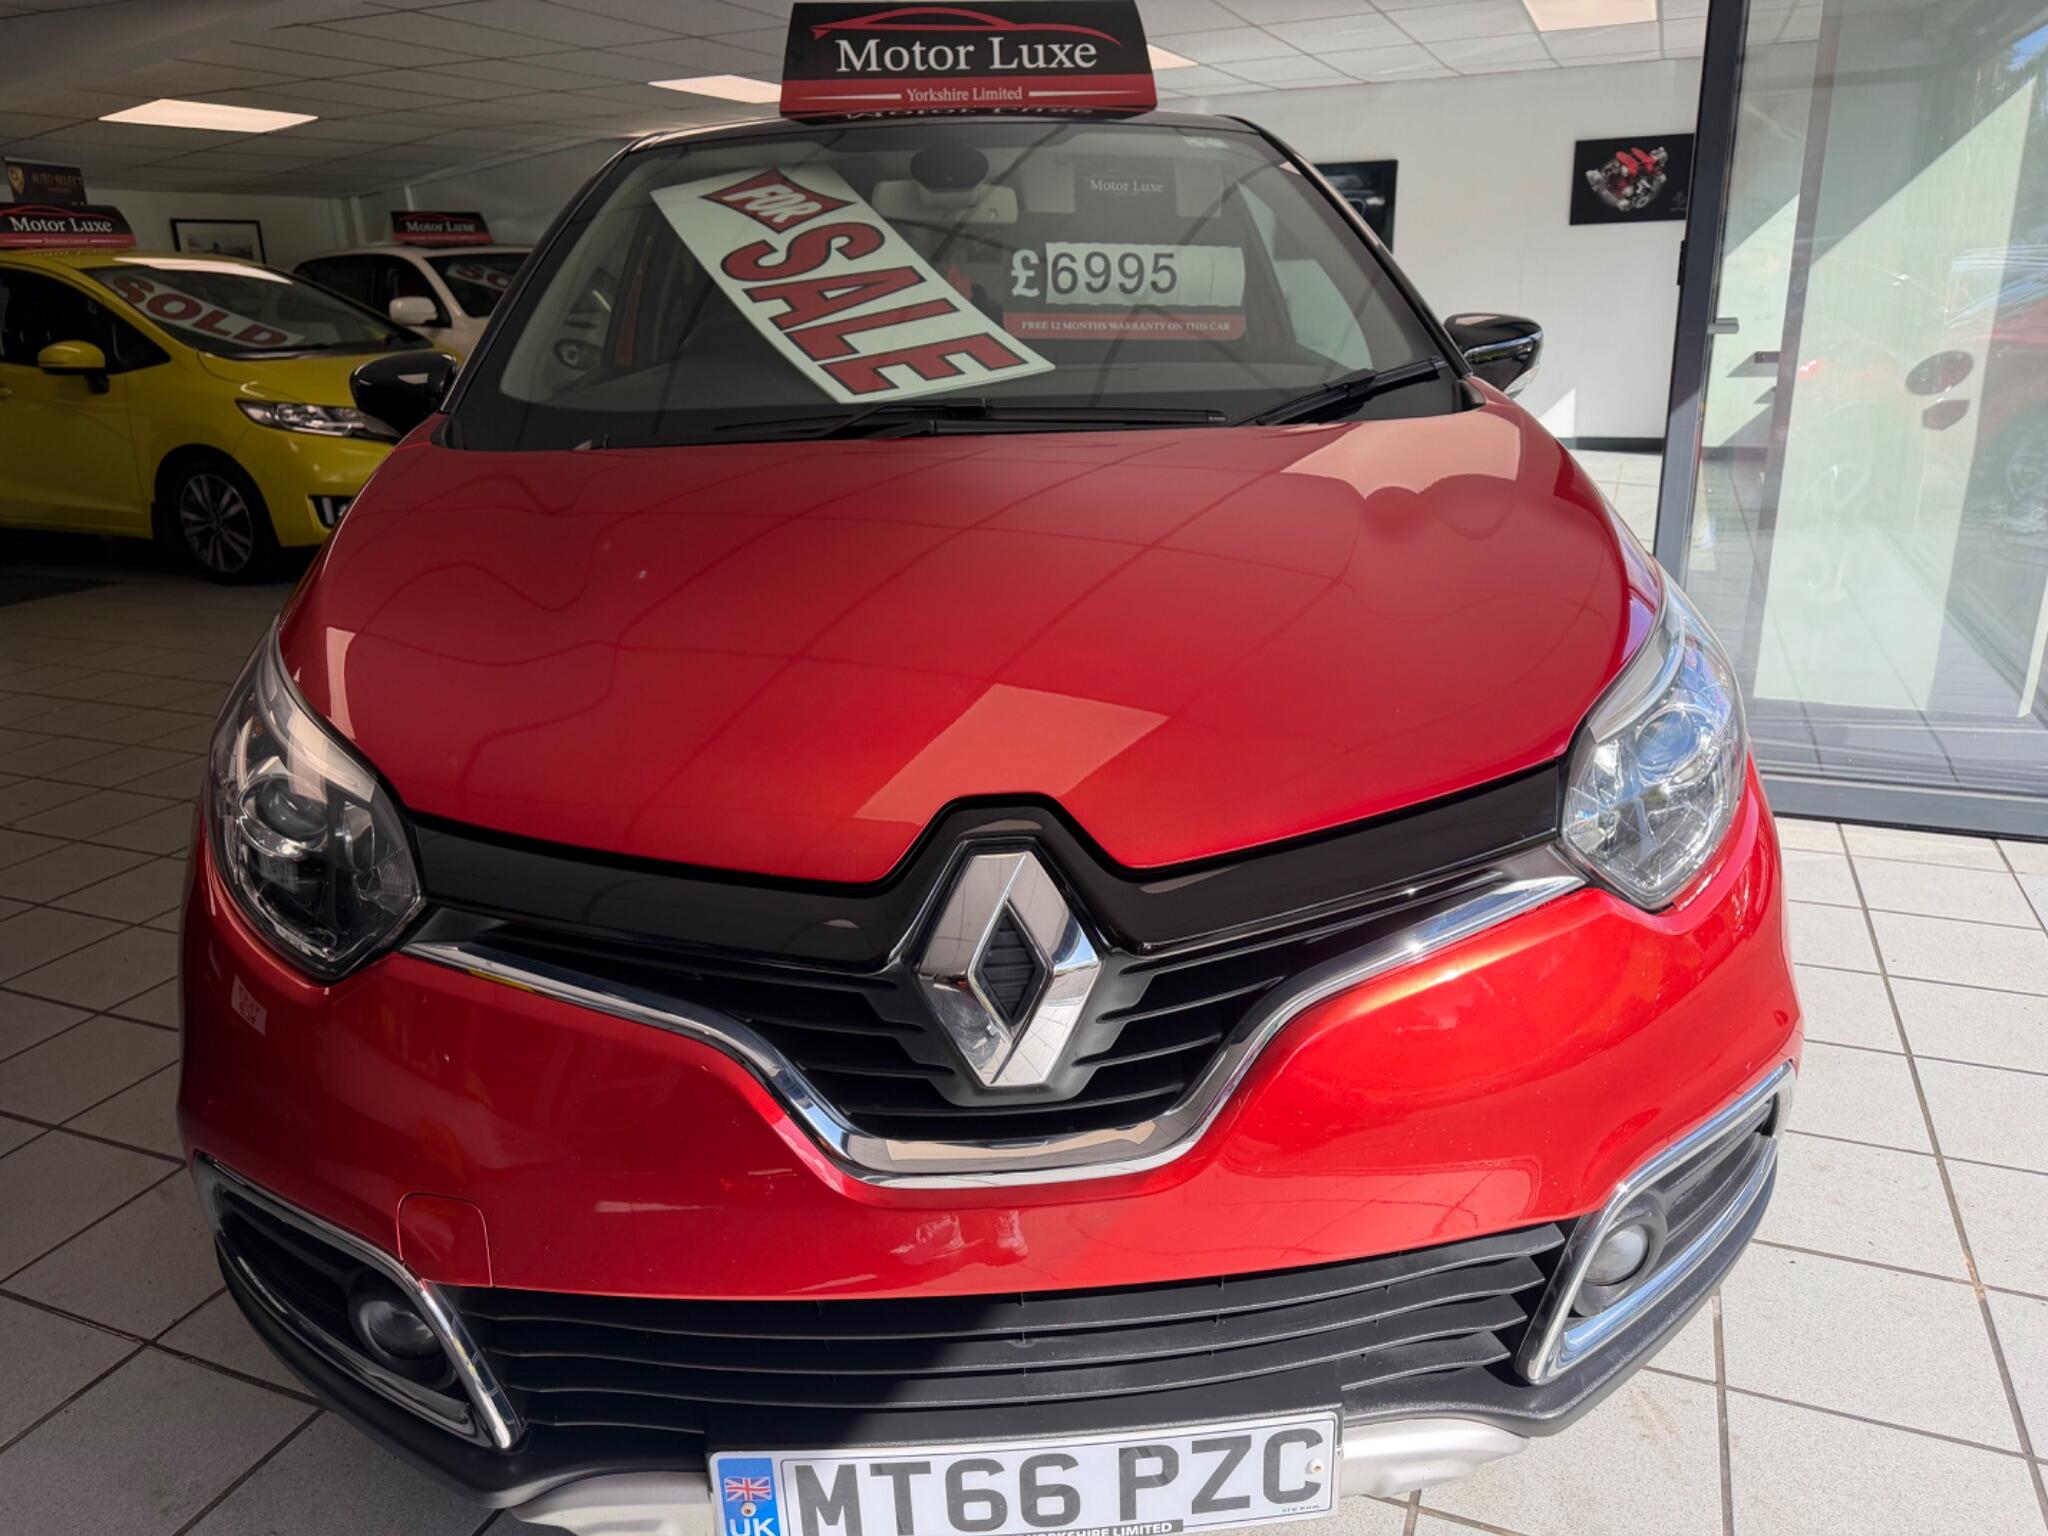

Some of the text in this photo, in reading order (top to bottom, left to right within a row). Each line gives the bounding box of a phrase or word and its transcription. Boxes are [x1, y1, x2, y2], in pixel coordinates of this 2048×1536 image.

[835, 36, 1098, 72] Motor Luxe
[906, 86, 1024, 103] Yorkshire Limited
[1090, 179, 1164, 193] Motor Luxe
[722, 185, 823, 223] FOR
[9, 216, 113, 232] Motor Luxe
[405, 220, 476, 232] Motor Luxe
[113, 276, 288, 346] SOLD
[720, 222, 1030, 396] SALE
[1022, 321, 1231, 332] FREE 12 MONTHS WARRANTY ON THIS CAR
[794, 1428, 1323, 1536] MT66 PZC
[729, 1517, 776, 1536] UK
[1112, 1522, 1172, 1536] LIMITED
